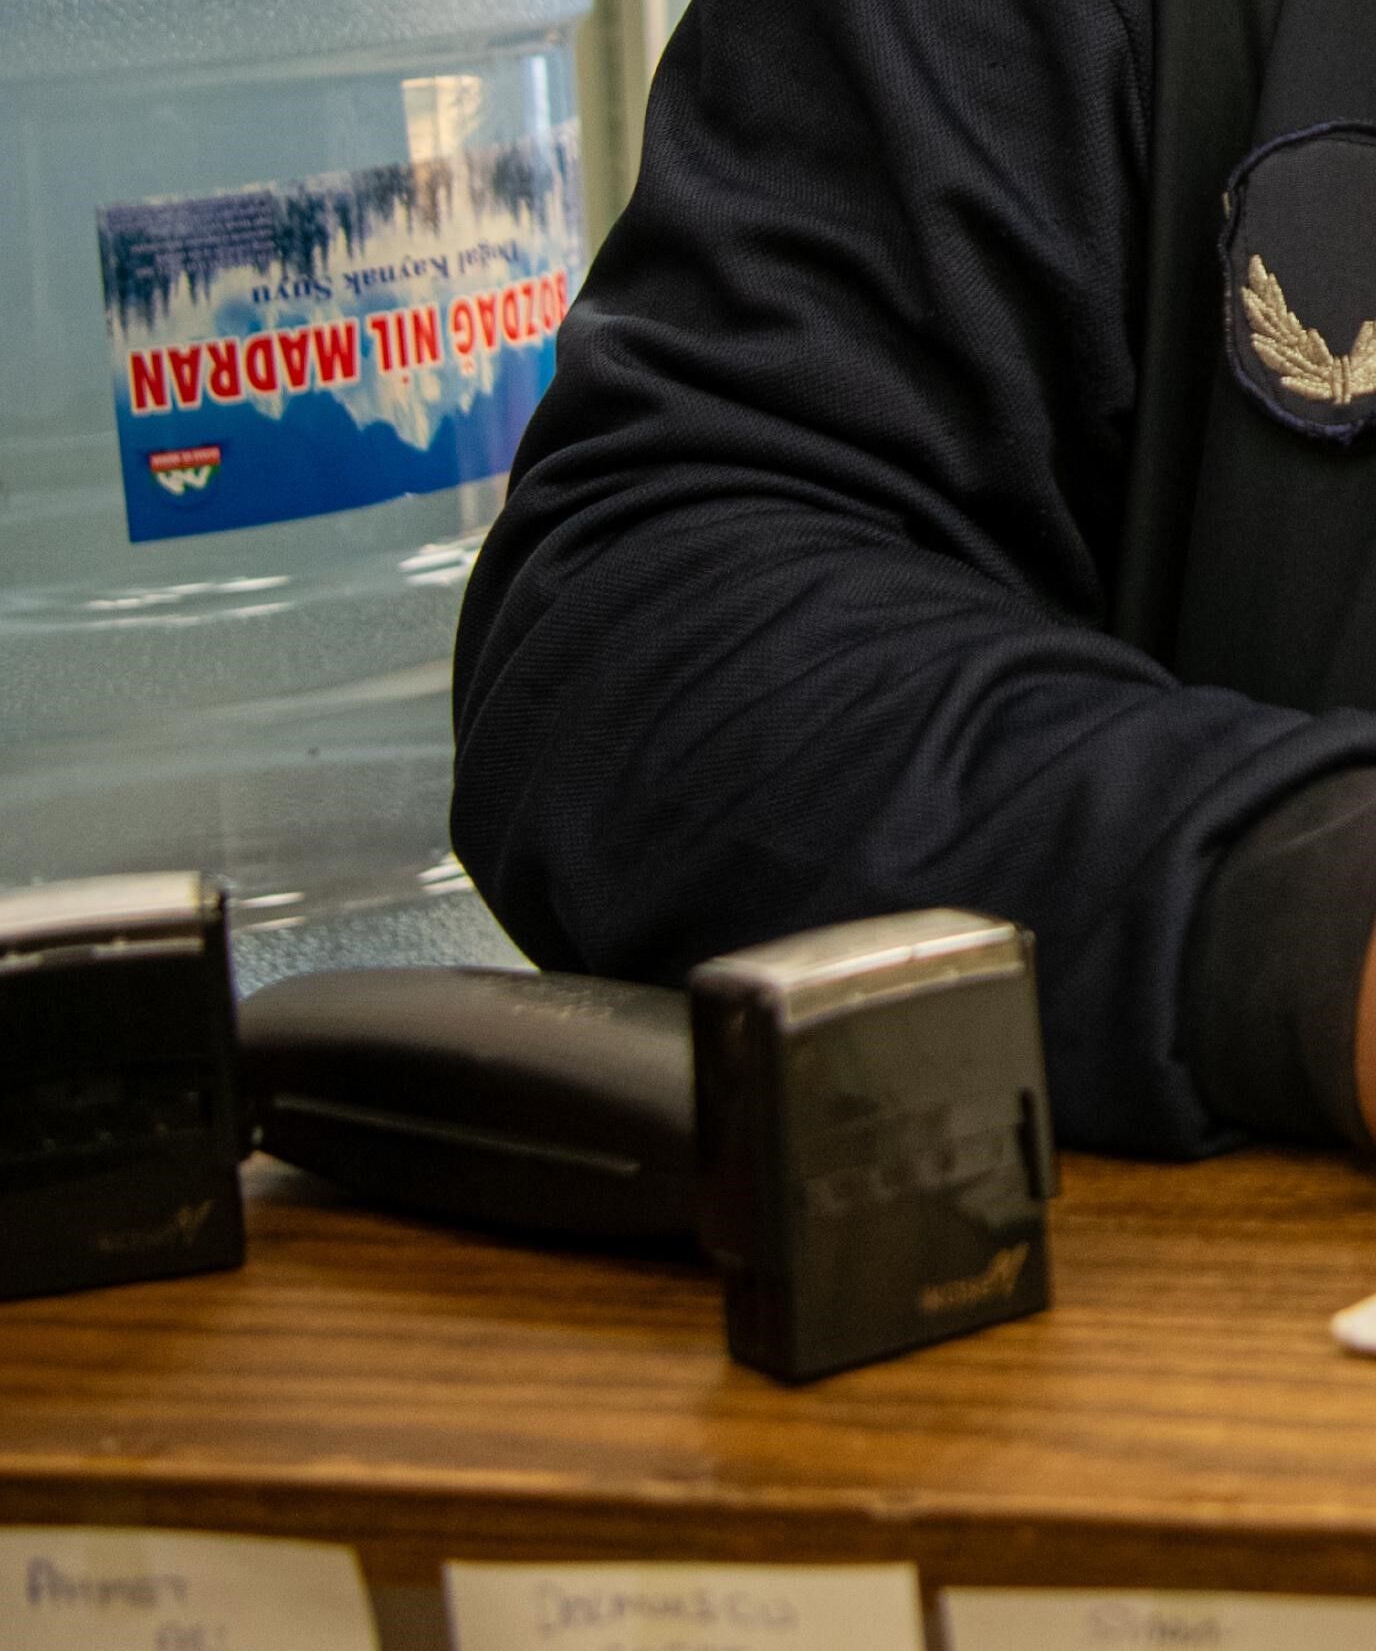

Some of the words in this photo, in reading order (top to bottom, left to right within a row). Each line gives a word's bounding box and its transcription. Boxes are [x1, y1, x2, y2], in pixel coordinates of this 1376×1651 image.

[252, 274, 333, 303] Suyu
[342, 255, 449, 295] Kaynak
[130, 318, 361, 412] MADRAN
[369, 305, 442, 385] NİL
